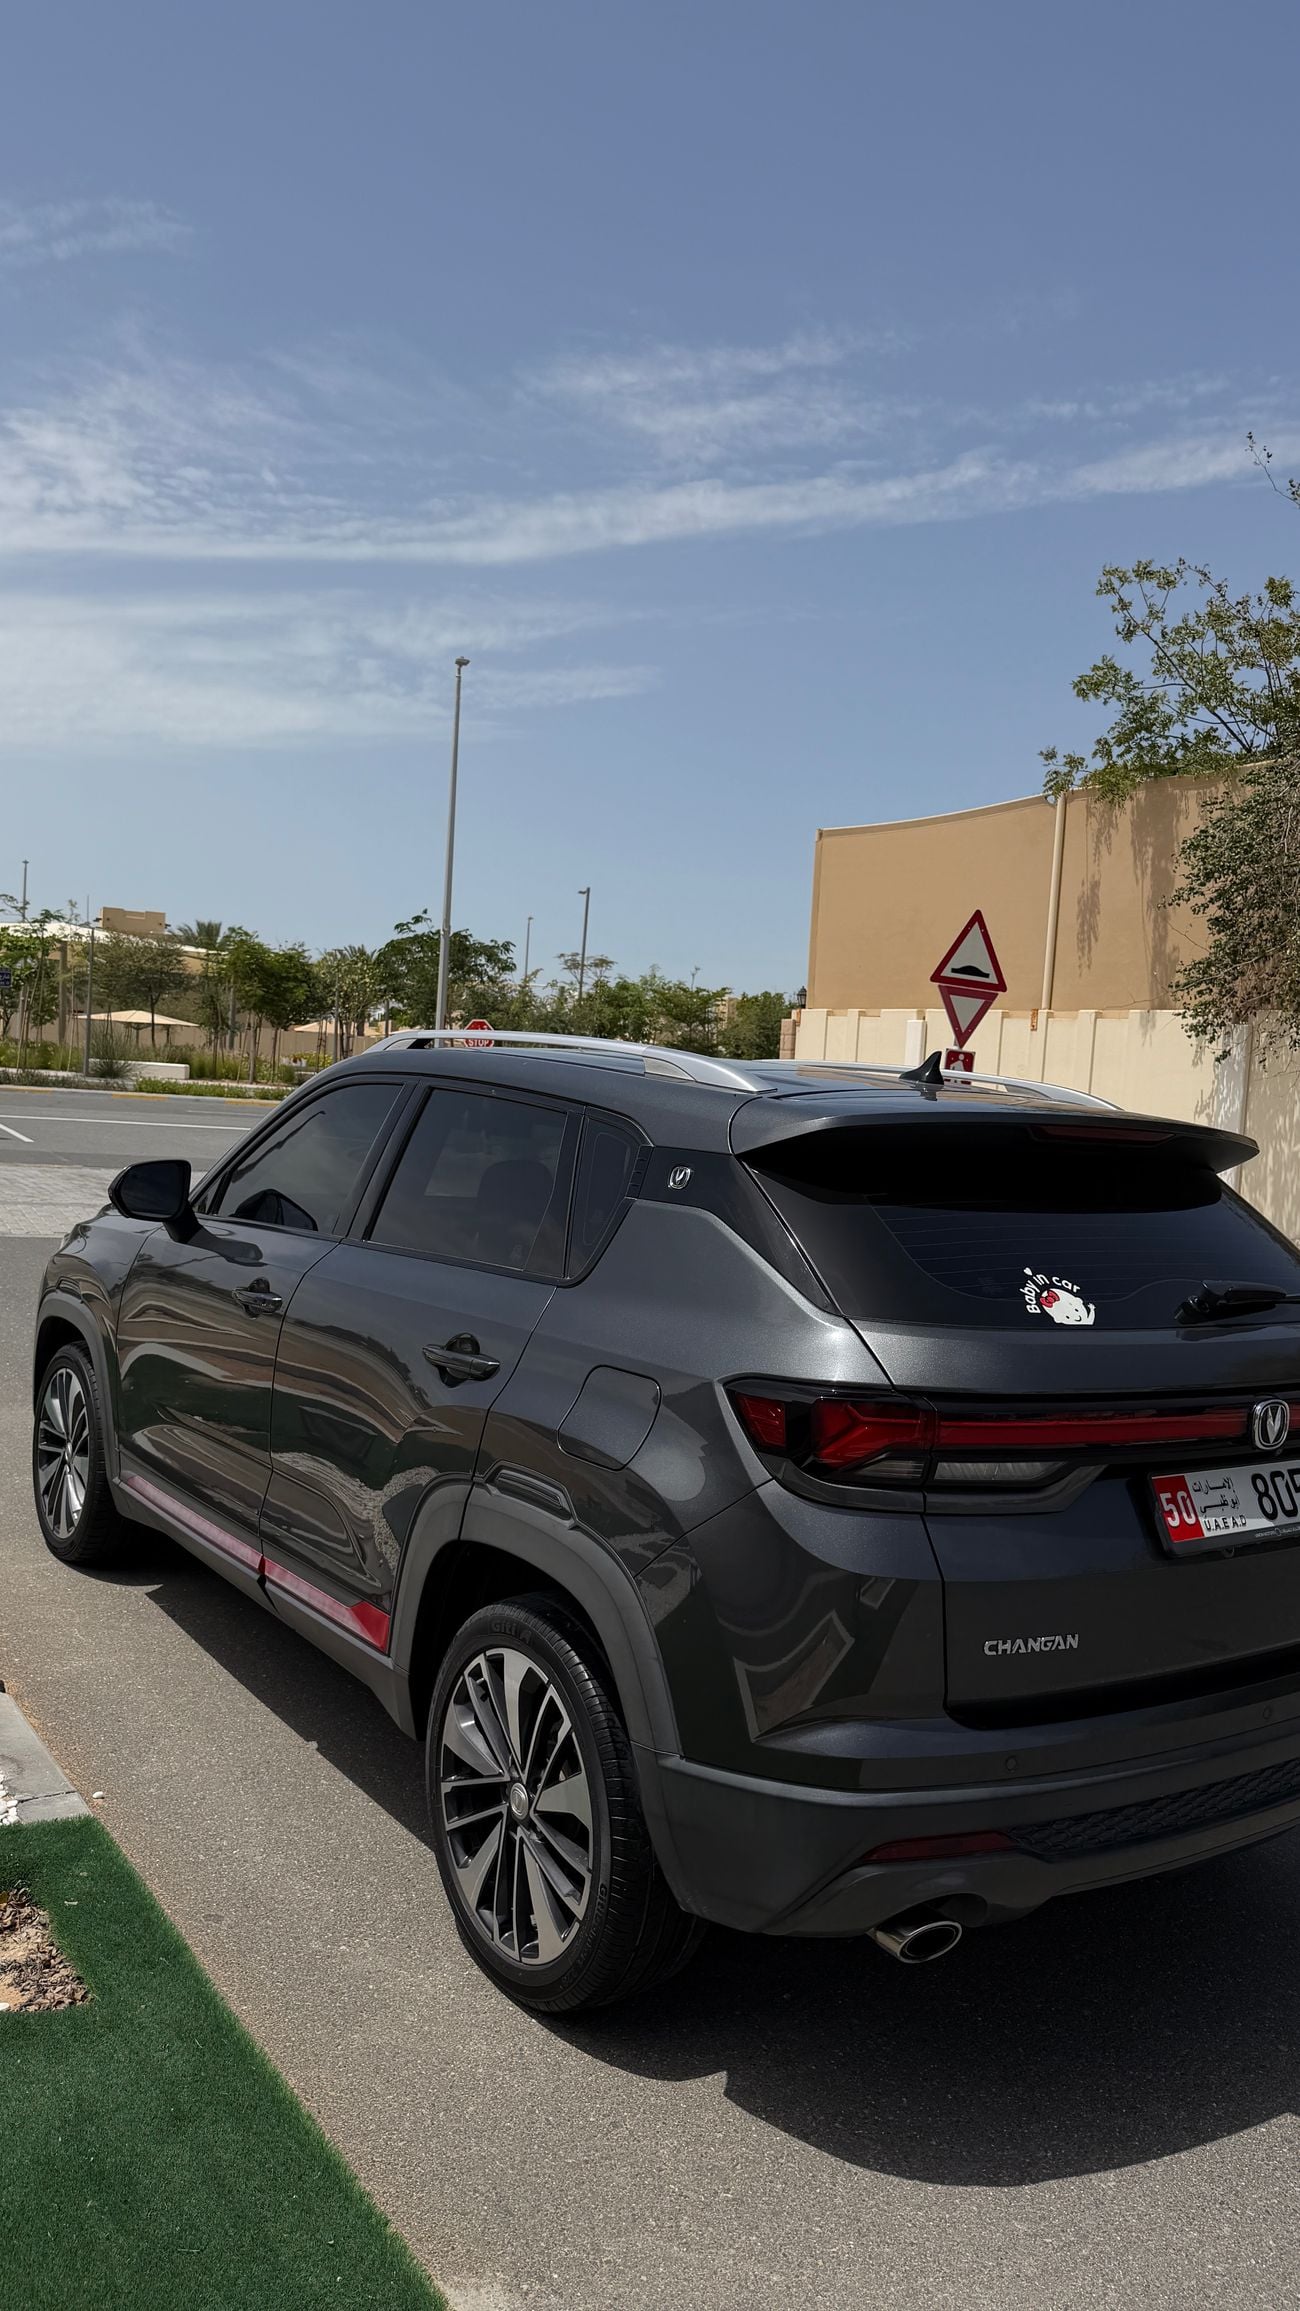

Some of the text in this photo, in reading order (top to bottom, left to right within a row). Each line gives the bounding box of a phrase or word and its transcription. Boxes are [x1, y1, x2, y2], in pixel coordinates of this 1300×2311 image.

[468, 1039, 489, 1047] STOP
[1019, 1274, 1081, 1313] Baby in car
[1160, 1491, 1197, 1528] 50
[983, 1633, 1079, 1656] CHANGAN
